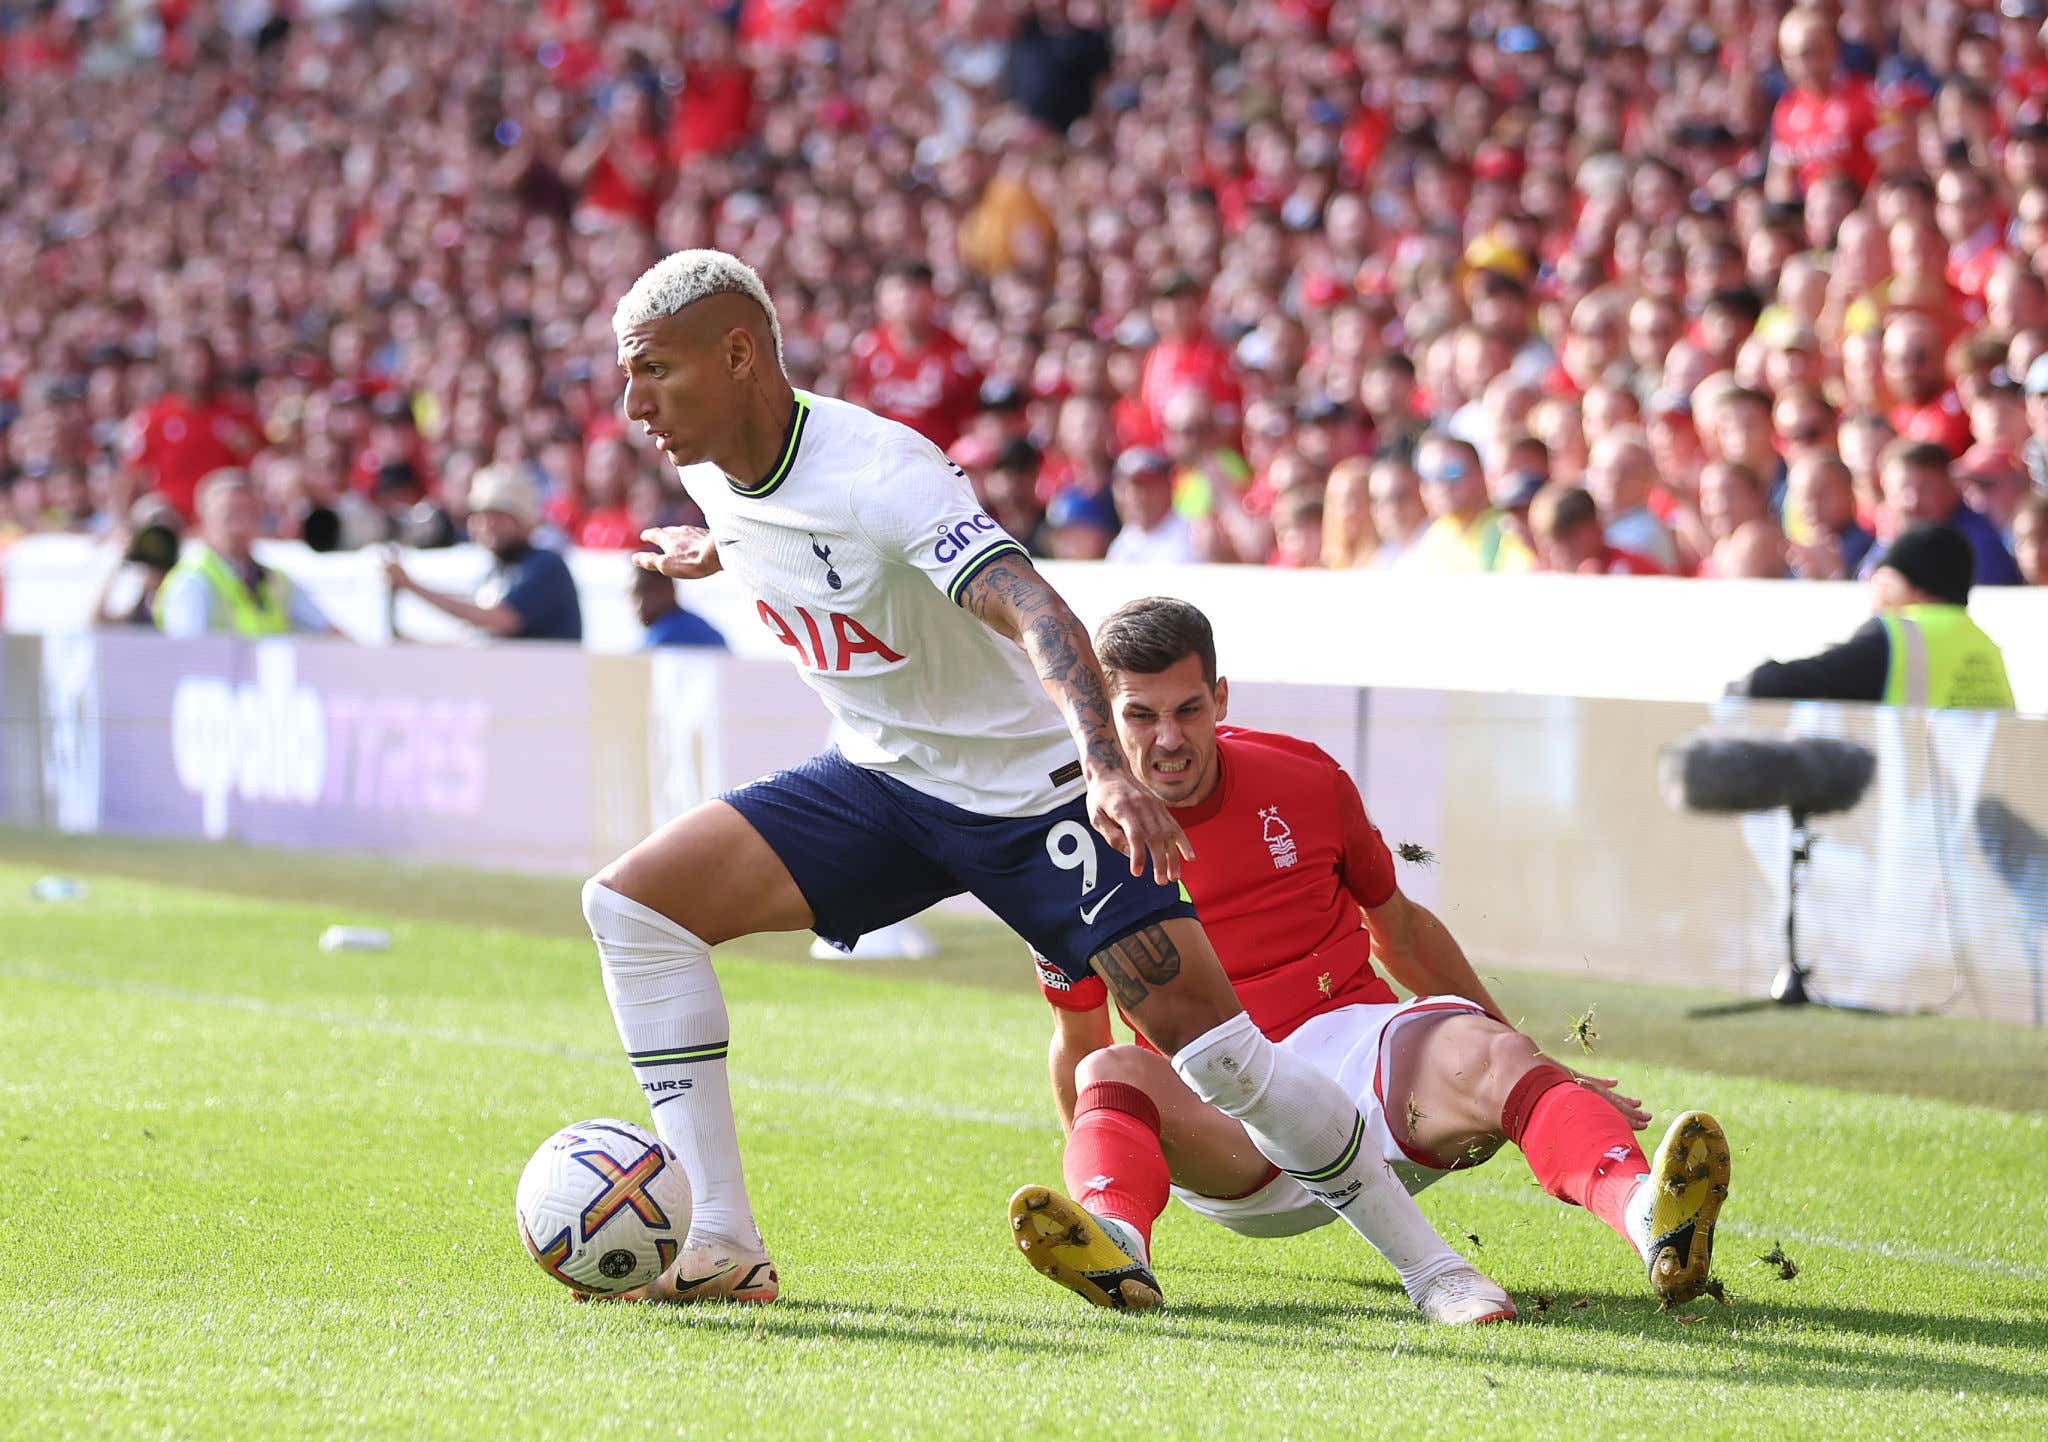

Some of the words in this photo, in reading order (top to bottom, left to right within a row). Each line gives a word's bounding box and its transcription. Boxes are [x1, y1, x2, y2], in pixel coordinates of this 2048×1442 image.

[934, 511, 998, 564] cinc
[756, 599, 906, 671] AIA
[1046, 820, 1097, 896] 9
